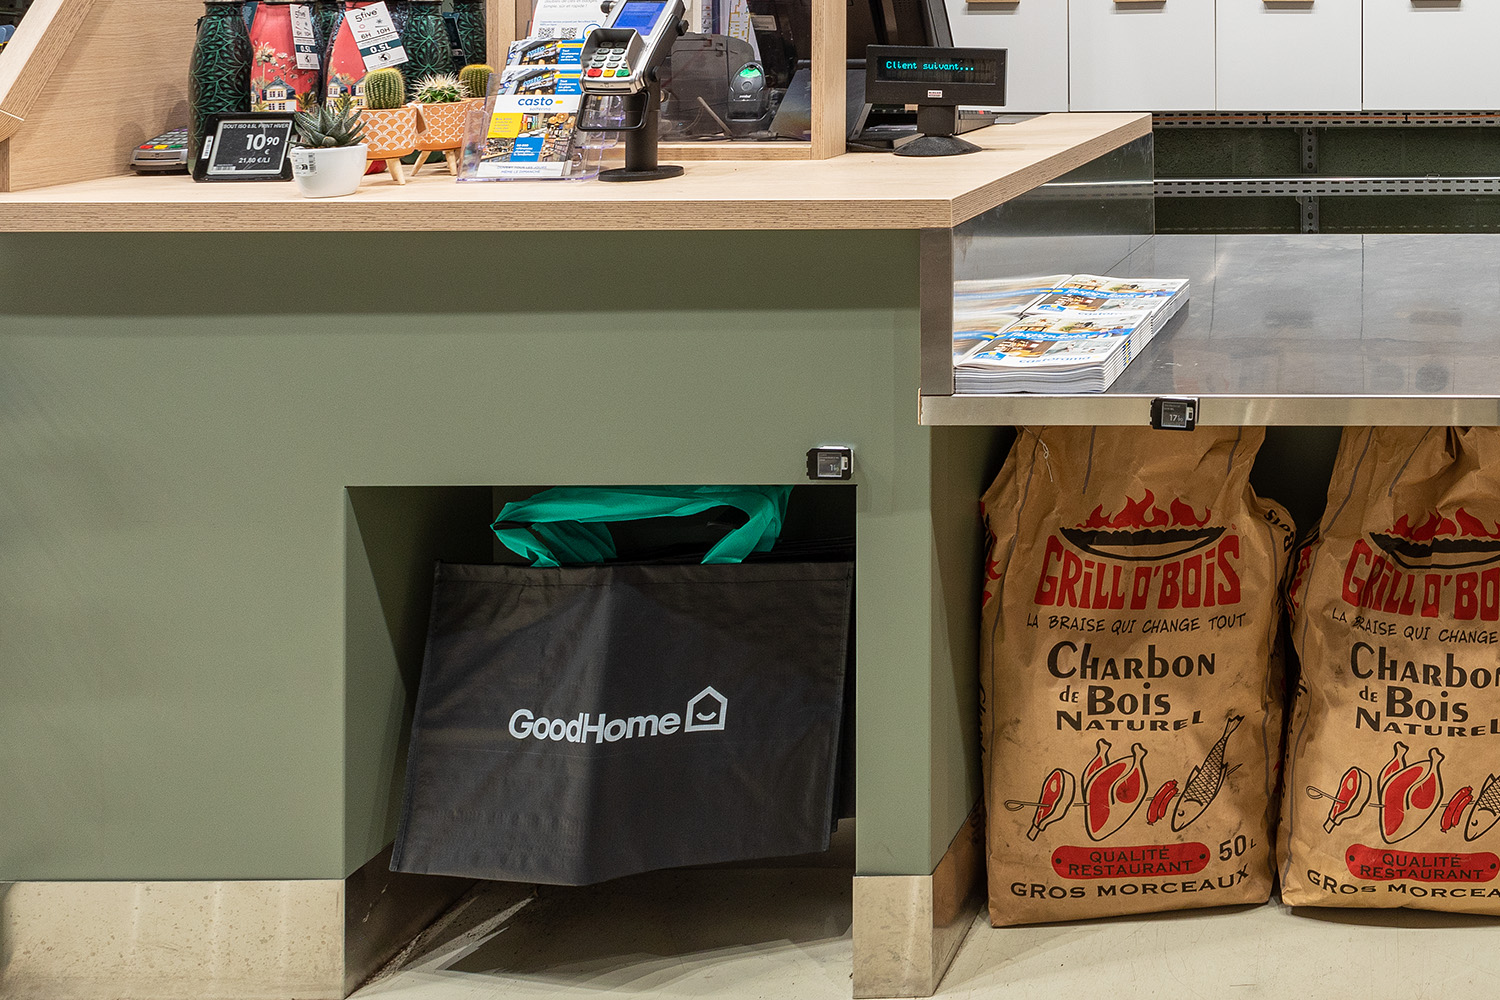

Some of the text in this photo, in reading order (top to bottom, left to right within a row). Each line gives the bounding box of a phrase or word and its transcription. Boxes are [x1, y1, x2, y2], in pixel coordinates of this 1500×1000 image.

[369, 42, 391, 54] 0.5L
[886, 61, 974, 72] Client suivant...
[518, 97, 553, 106] casto
[1027, 612, 1247, 635] LA BRAISE QUI CHANGE TOUT
[1332, 608, 1348, 623] LA
[1403, 626, 1431, 641] QUI
[1438, 628, 1499, 645] CHANGE
[1086, 683, 1172, 717] Bois
[1385, 684, 1470, 724] Bois
[508, 708, 681, 744] GoodHome
[1088, 845, 1170, 864] QUALITÉ
[1381, 850, 1463, 871] QUALITÉ
[1067, 858, 1195, 878] RESTAURANT
[1359, 862, 1485, 882] RESTAURANT
[1009, 865, 1251, 901] GROS MORCEAUX
[1306, 869, 1377, 898] GROS
